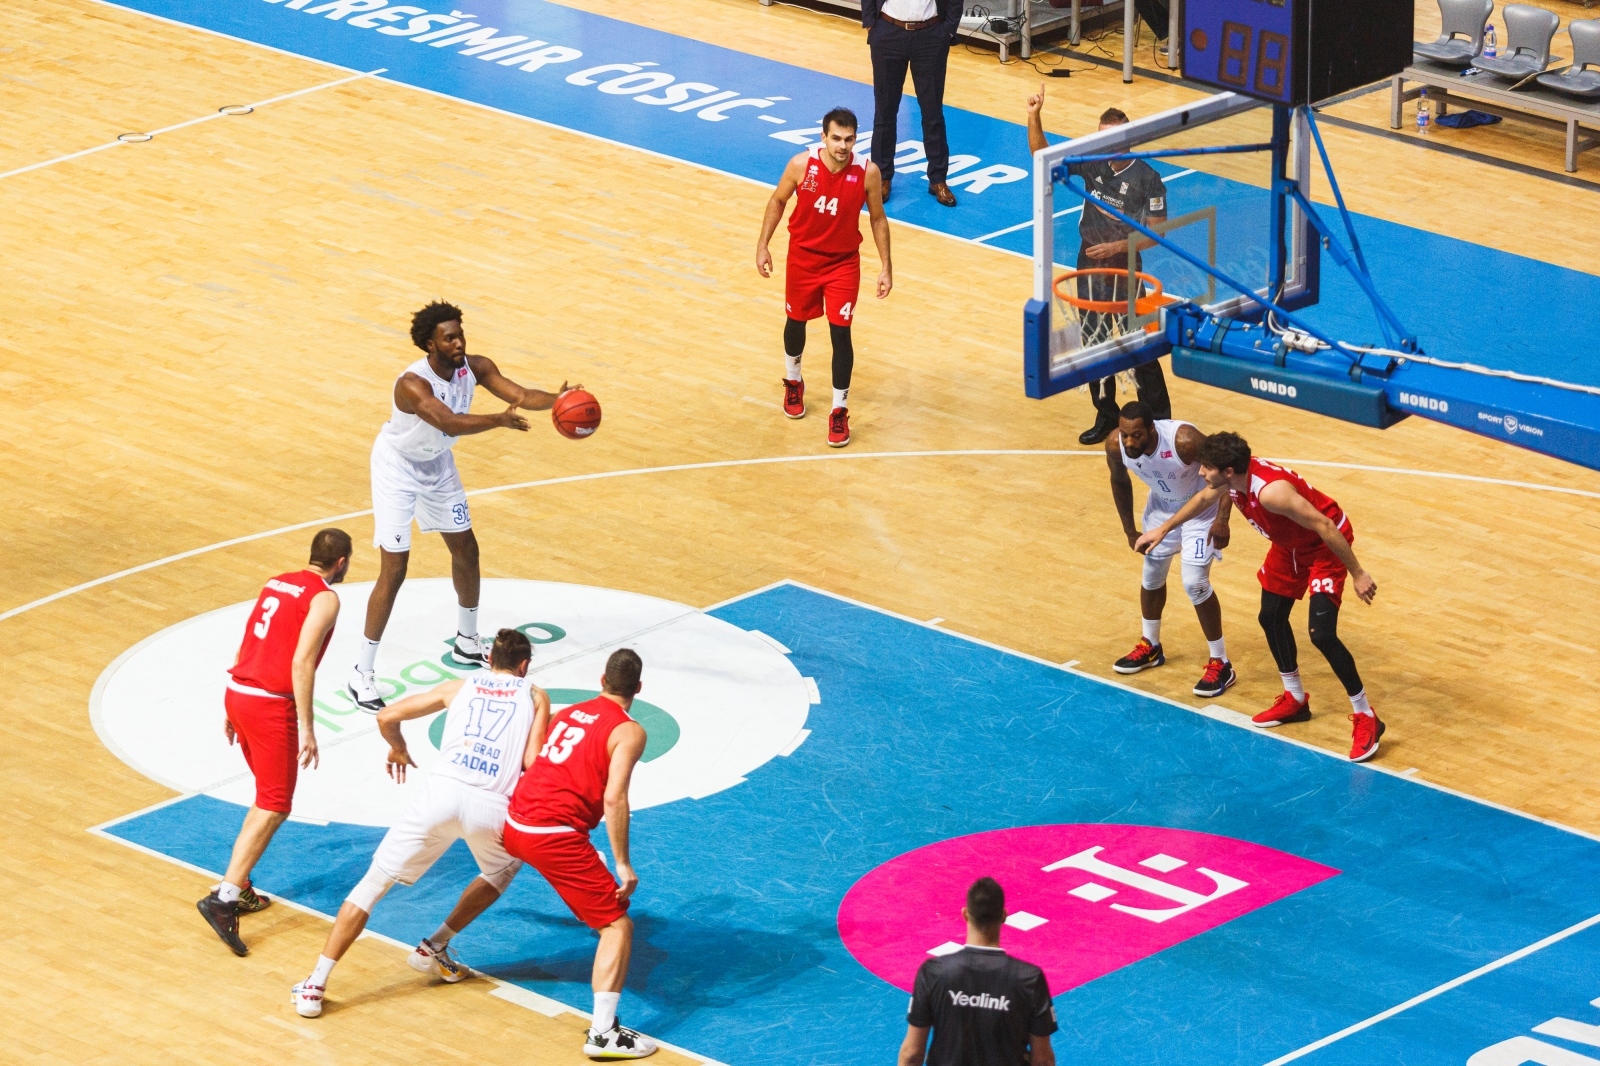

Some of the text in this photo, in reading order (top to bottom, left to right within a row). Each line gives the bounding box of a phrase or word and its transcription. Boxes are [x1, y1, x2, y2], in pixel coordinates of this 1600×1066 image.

[262, 0, 583, 72] REŠIMIR
[814, 195, 839, 216] 44
[1399, 391, 1449, 413] MONDO
[1477, 412, 1543, 436] SPORT VISION
[1195, 538, 1204, 559] 1
[253, 596, 280, 639] 3
[475, 686, 518, 698] TOMMY
[464, 697, 517, 742] 17
[473, 742, 501, 760] GRAD
[538, 720, 585, 764] 13
[451, 752, 500, 778] ZADAR
[948, 989, 1011, 1012] Yealink
